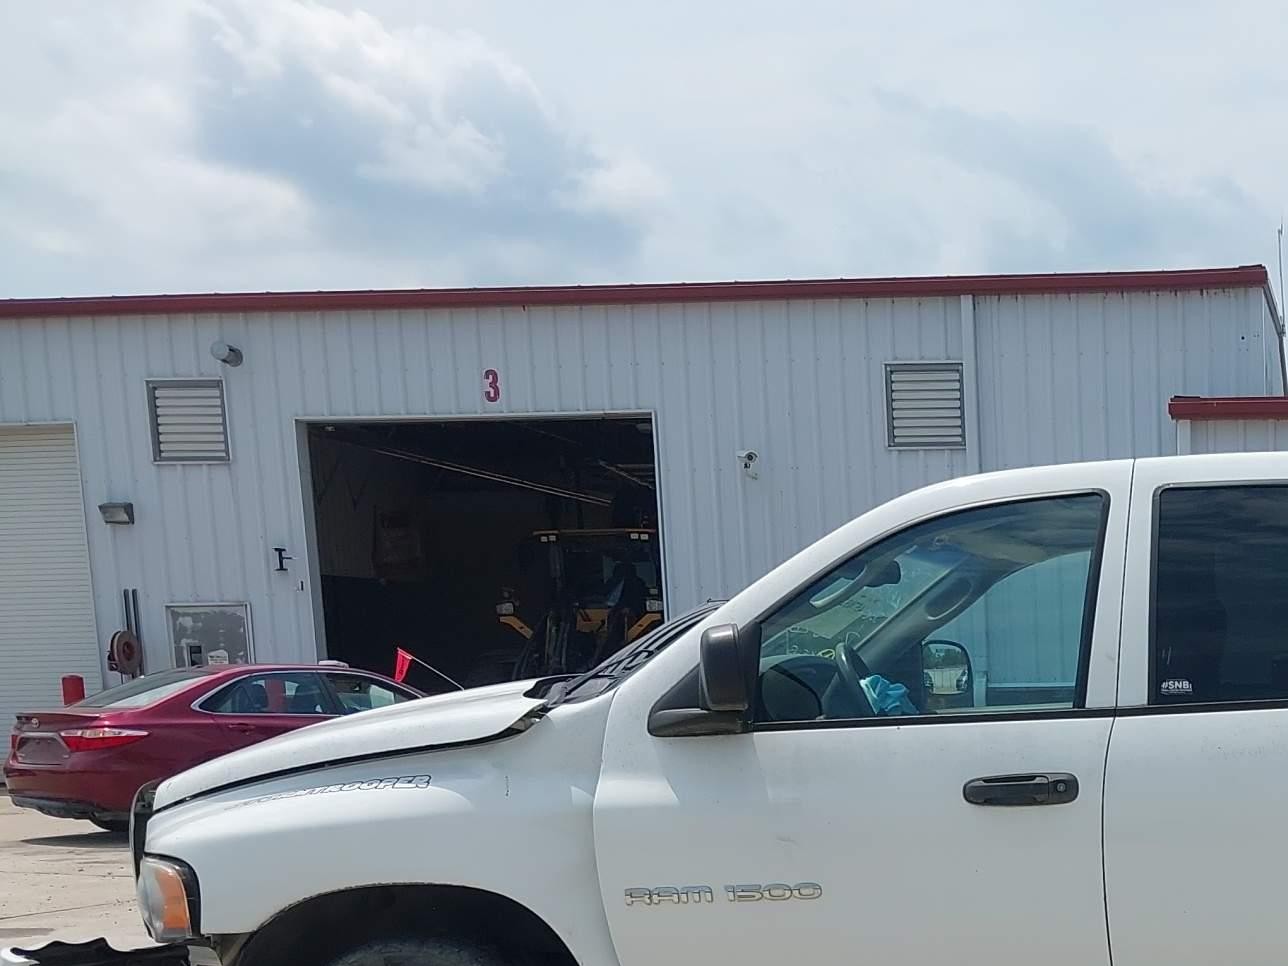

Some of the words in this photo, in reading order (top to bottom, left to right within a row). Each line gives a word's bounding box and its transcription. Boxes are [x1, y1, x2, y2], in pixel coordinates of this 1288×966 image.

[482, 368, 501, 403] 3
[624, 885, 714, 906] RAM
[724, 882, 823, 903] 1500
